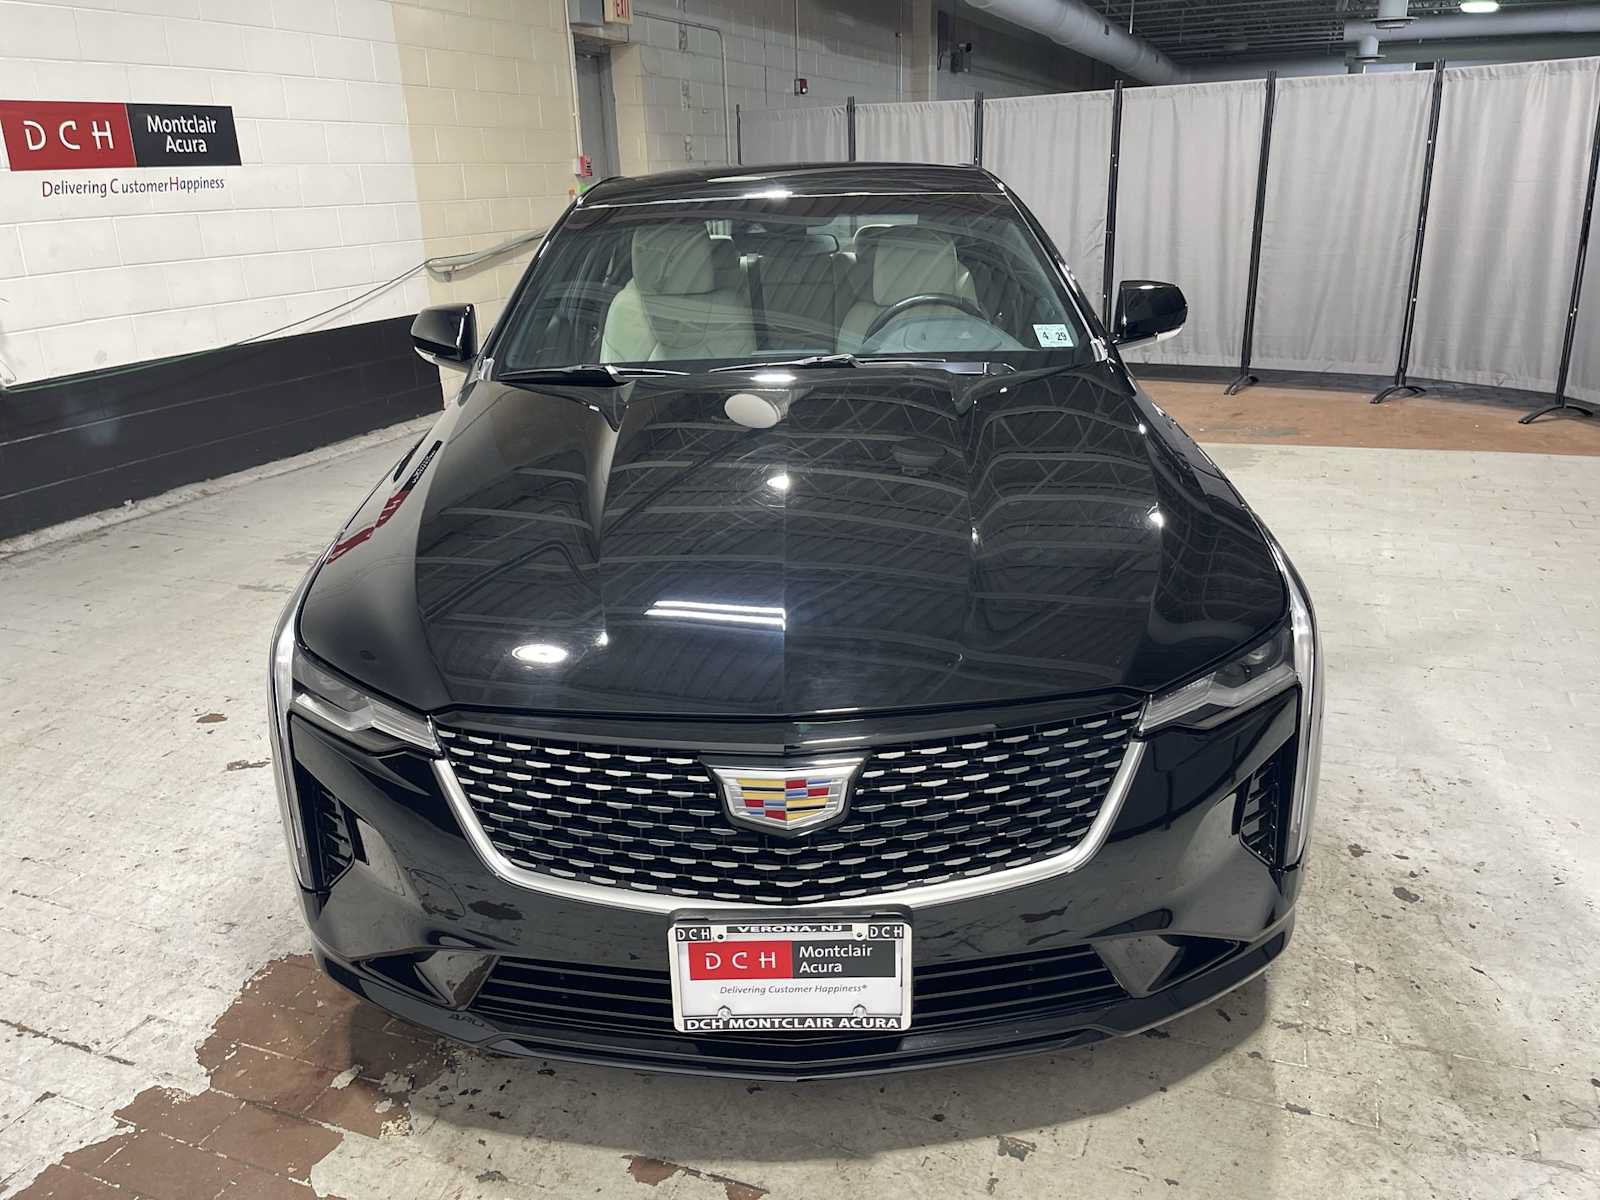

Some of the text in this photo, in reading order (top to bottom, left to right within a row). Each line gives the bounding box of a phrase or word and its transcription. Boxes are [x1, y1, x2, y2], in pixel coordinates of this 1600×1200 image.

[146, 114, 217, 135] Montclair
[165, 135, 208, 153] Acura
[42, 180, 107, 198] Delivering
[1042, 331, 1068, 341] 4 29
[677, 928, 710, 941] DCH
[869, 925, 904, 938] DCH
[799, 944, 873, 958] Montclair
[704, 951, 777, 970] DCH
[799, 961, 843, 974] Acura
[719, 985, 766, 996] Delivering
[768, 984, 813, 994] Customer
[686, 1018, 900, 1030] DCH MONTCLAIR ACURA
